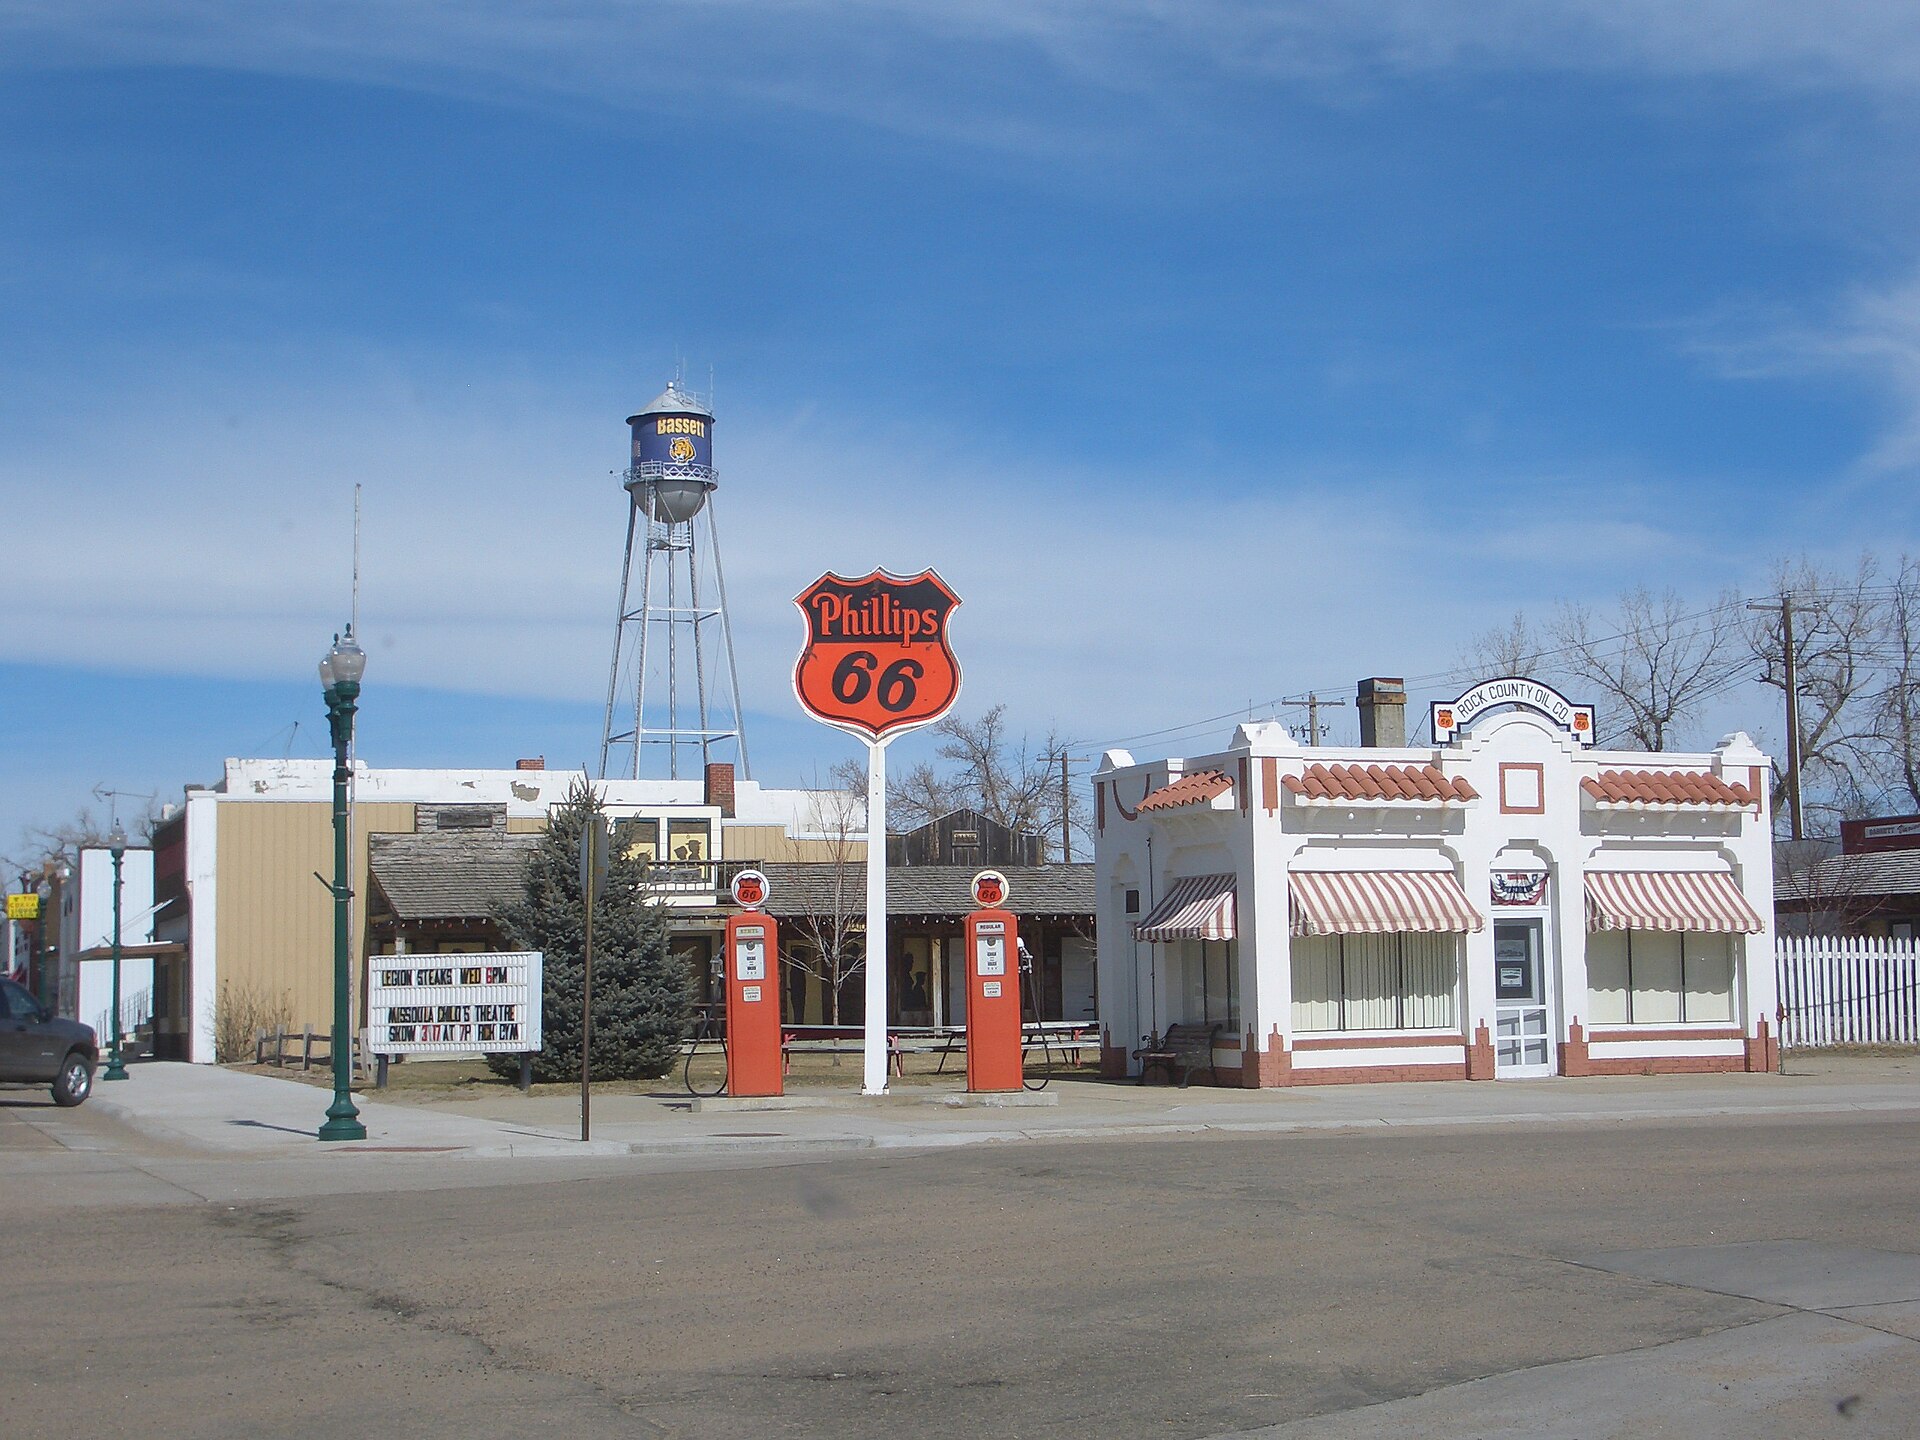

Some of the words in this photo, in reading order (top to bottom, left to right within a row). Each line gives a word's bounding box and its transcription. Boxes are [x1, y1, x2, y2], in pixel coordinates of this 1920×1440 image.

[657, 416, 705, 438] Bassett
[812, 592, 939, 648] Phillips
[832, 650, 924, 712] 66
[1457, 690, 1488, 718] ROCK
[1488, 683, 1534, 700] COUNTY
[1535, 689, 1550, 708] OIL
[1552, 703, 1569, 722] CO.
[742, 890, 757, 900] 66
[982, 890, 997, 900] 66
[382, 970, 412, 986] LEGION
[418, 968, 452, 985] STEAKS
[460, 968, 481, 984] WED
[486, 967, 507, 984] 6PM
[389, 1006, 433, 1024] MISSOULA
[475, 1005, 515, 1022] THEATRE
[389, 1026, 416, 1042] SHOW
[444, 1025, 455, 1041] AT
